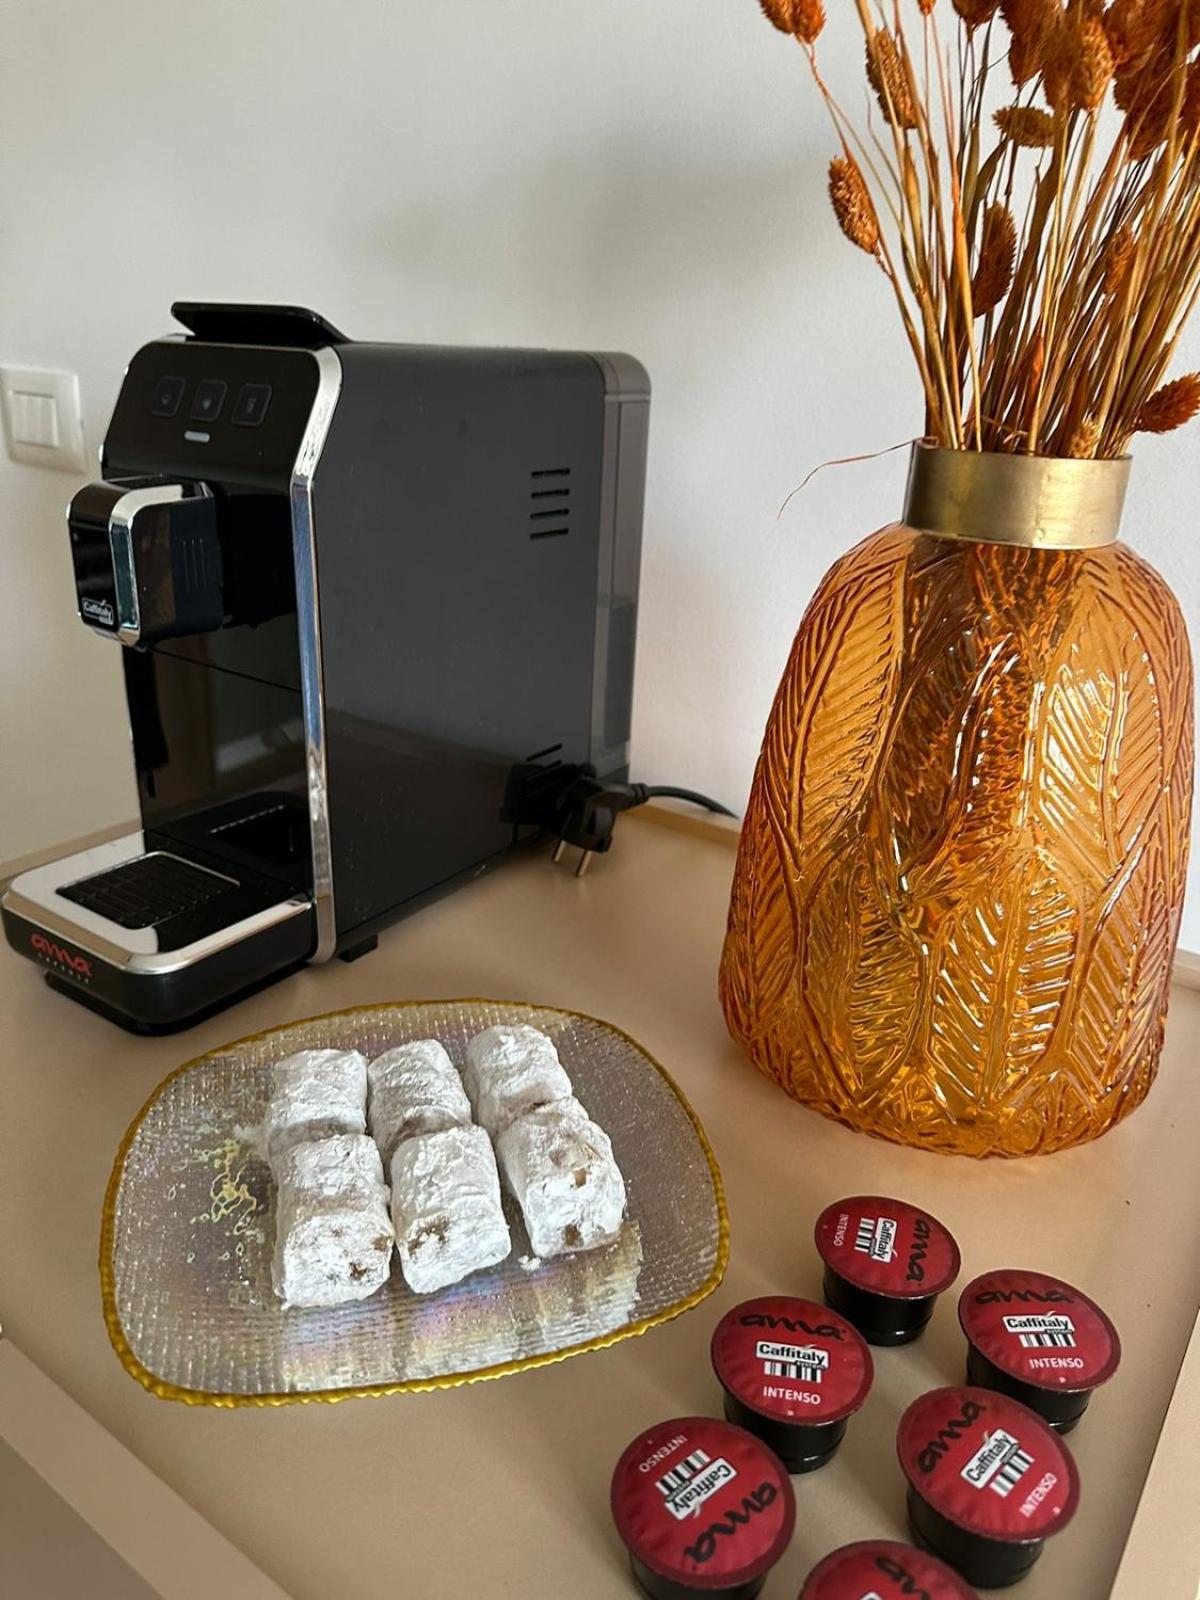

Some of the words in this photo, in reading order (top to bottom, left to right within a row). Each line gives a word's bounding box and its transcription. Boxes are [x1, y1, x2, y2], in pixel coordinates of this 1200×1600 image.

[833, 1213, 849, 1247] INTENSO
[874, 1220, 895, 1260] Caffitaly
[1006, 1313, 1069, 1331] Caffitaly
[759, 1343, 825, 1365] Caffitaly
[1028, 1356, 1084, 1369] INTENSO
[763, 1386, 821, 1405] INTENSO
[639, 1434, 688, 1473] INTENSO
[965, 1434, 1012, 1482] Caffitaly
[673, 1464, 732, 1512] Caffitaly
[1019, 1472, 1058, 1517] INTENSO
